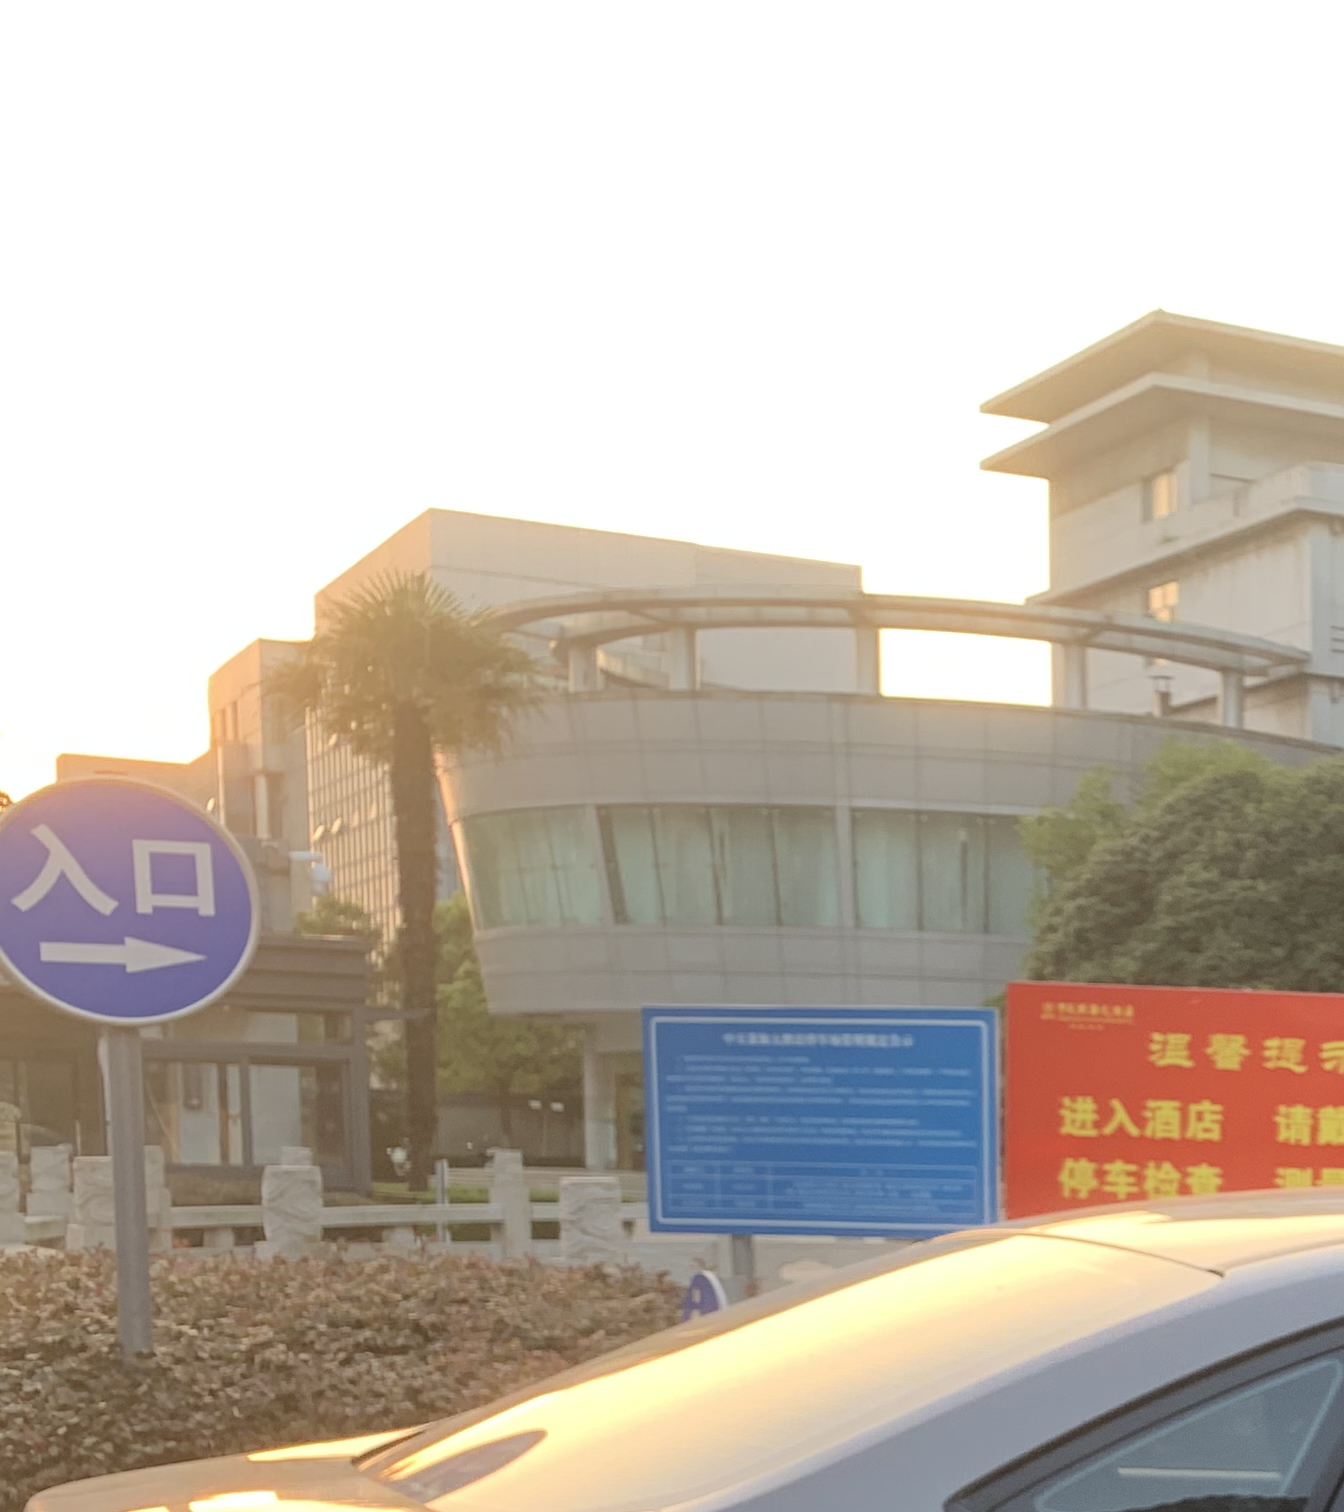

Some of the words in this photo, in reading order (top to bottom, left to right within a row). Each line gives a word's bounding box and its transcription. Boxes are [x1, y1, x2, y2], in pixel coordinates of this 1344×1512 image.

[12, 823, 217, 918] 入口
[1058, 1096, 1224, 1142] 进入酒店
[1057, 1157, 1223, 1200] 停车检查
